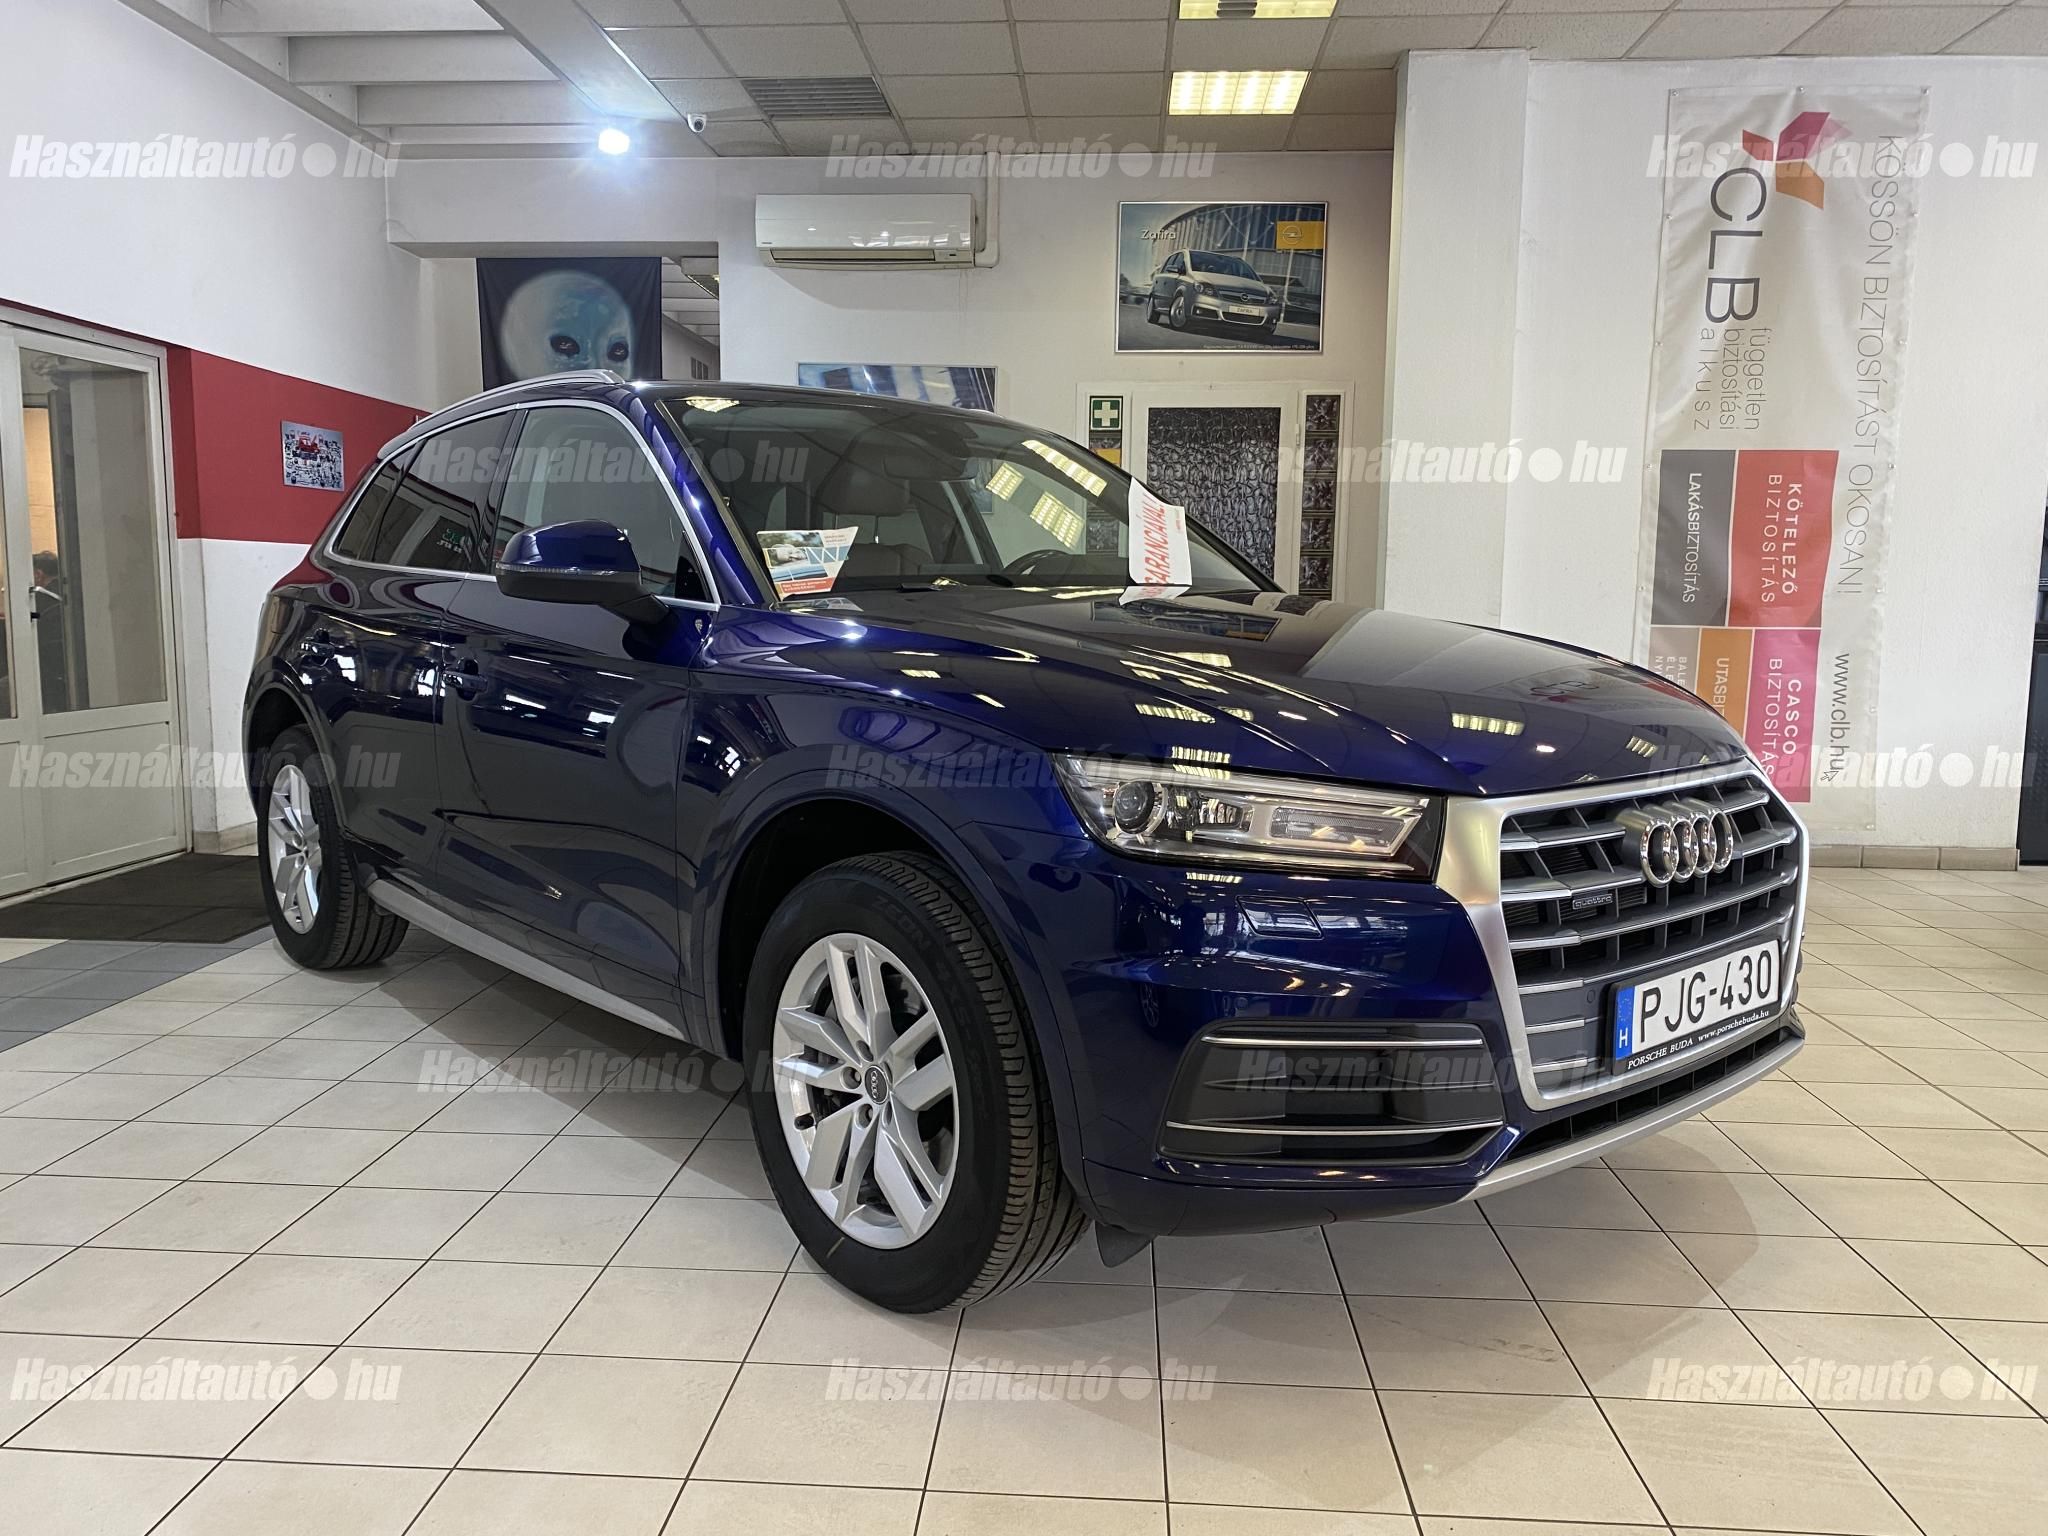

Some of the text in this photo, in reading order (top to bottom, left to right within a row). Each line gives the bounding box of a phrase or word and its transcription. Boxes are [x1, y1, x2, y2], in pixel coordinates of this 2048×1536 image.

[1704, 167, 1768, 323] CLB
[1865, 135, 1905, 265] KÖSSÖN
[1720, 328, 1745, 430] biztosítási
[1743, 327, 1772, 430] független
[1853, 276, 1889, 455] BIZTOSÍTÁST
[1682, 472, 1703, 603] LAKÁSBIZTOSÍTÁS
[1761, 474, 1783, 603] BIZTOSÍTÁS
[1782, 483, 1803, 595] KÖTELEZŐ
[1760, 658, 1783, 775] BIZTOSÍTÁS
[1782, 678, 1802, 755] CASCO
[1830, 652, 1851, 770] www.clb.hu
[1619, 1027, 1629, 1049] H
[1627, 1009, 1770, 1070] PORSCHE BUDA www.porschebuda.hu
[1640, 949, 1772, 1044] PJG-430
